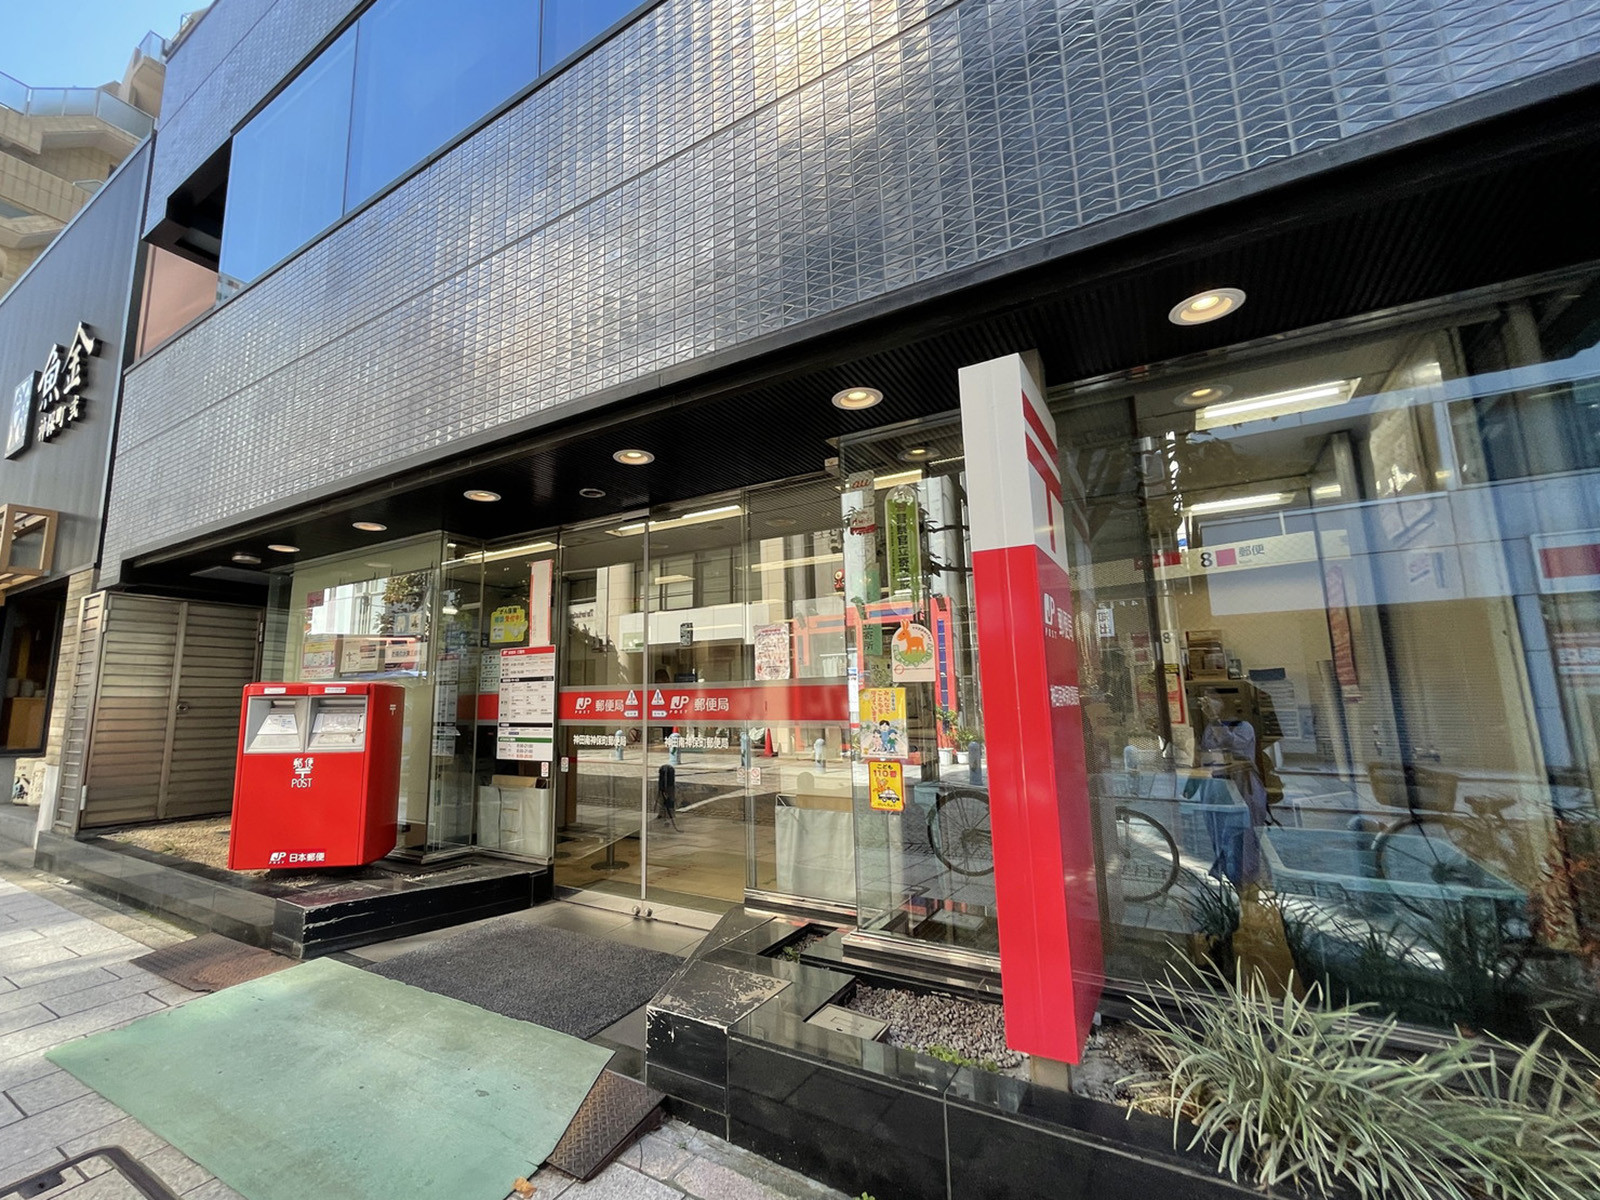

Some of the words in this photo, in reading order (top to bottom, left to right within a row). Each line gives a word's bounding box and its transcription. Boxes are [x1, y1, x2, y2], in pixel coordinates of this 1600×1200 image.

[1200, 552, 1213, 568] 8
[595, 698, 625, 712] 郵便局
[694, 697, 730, 712] 郵便局
[293, 757, 314, 770] 郵便
[291, 777, 313, 789] POST
[289, 852, 325, 863] 日本郵便
